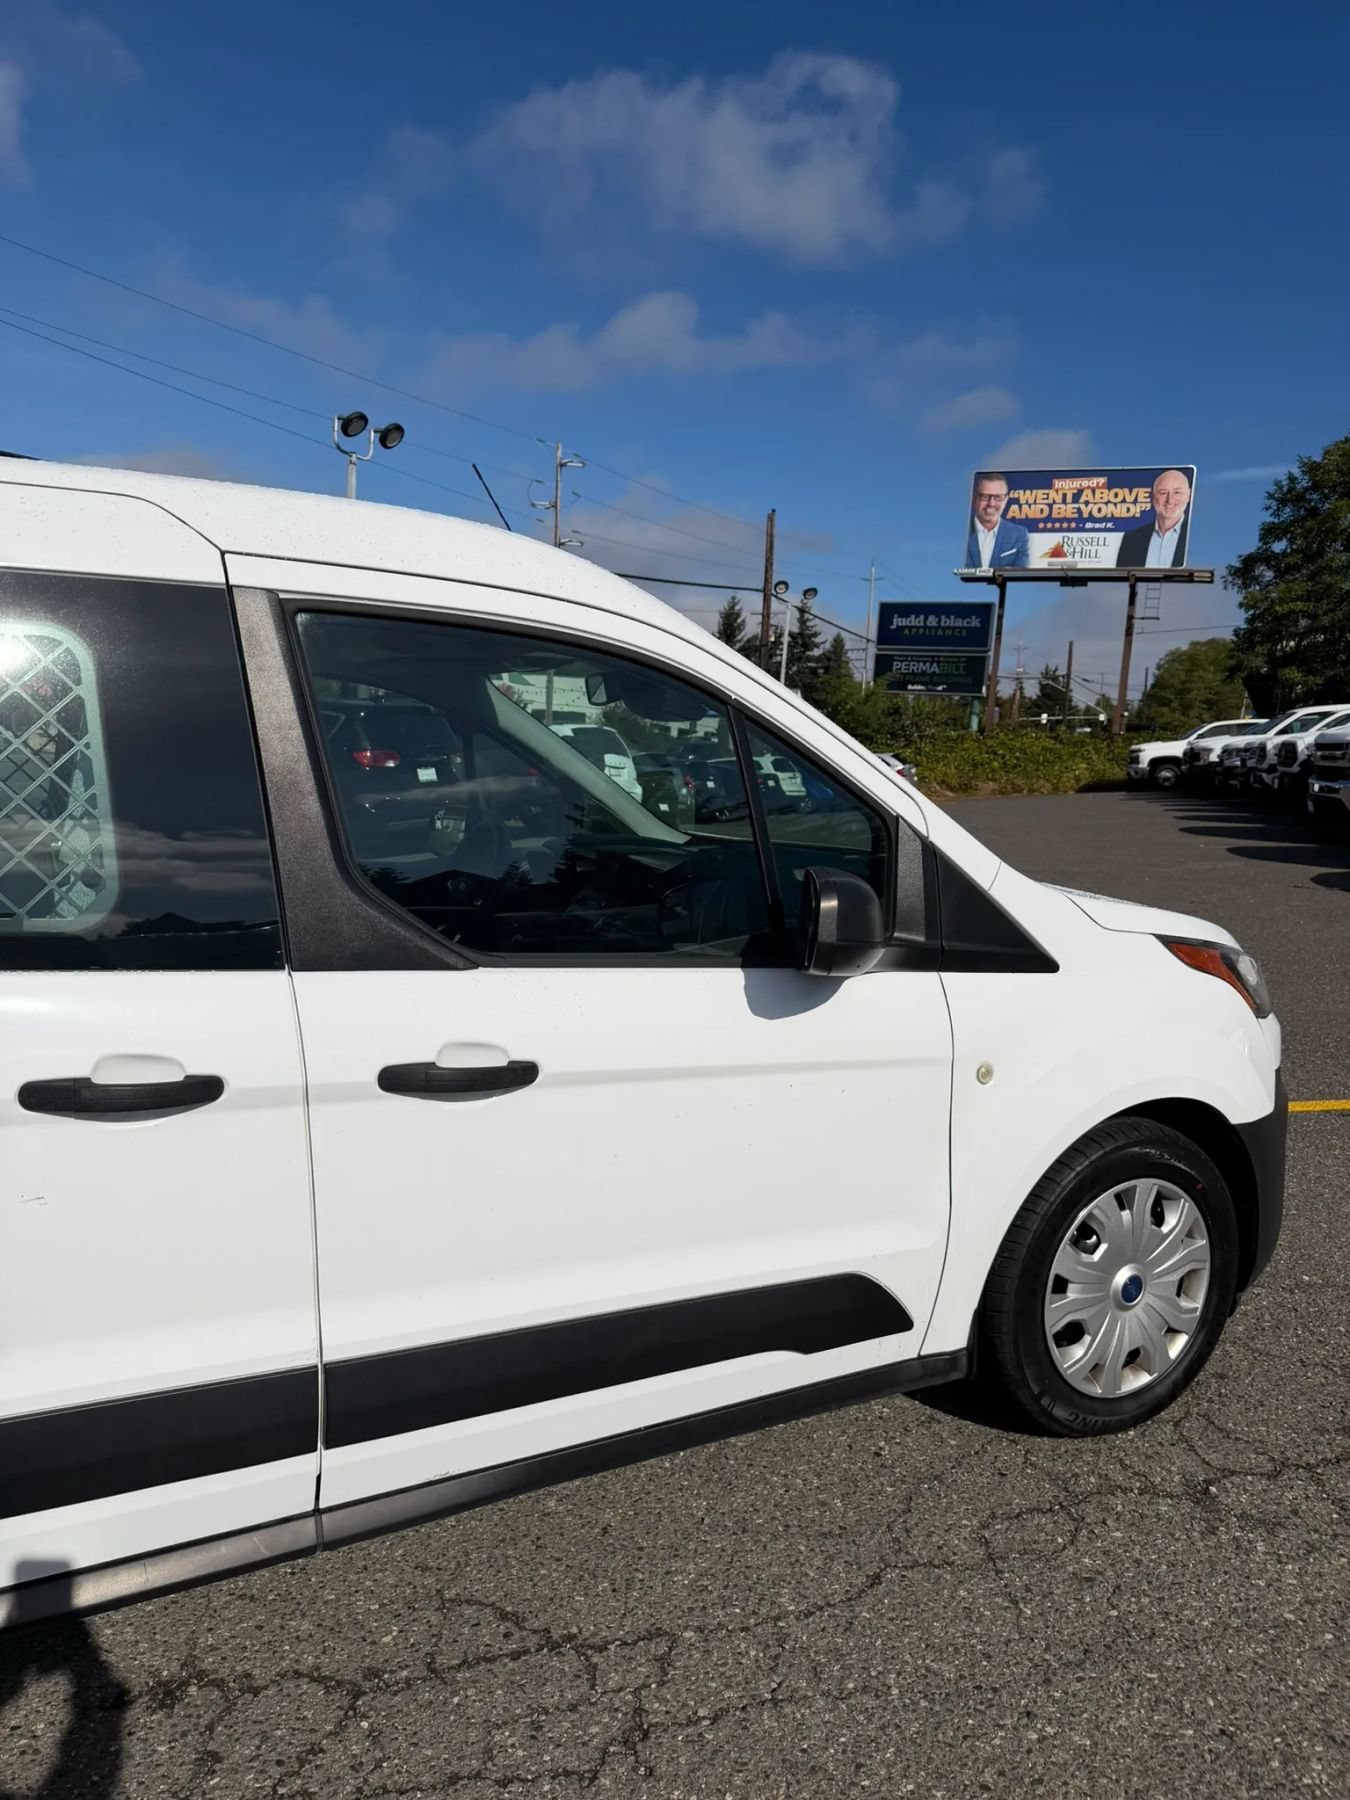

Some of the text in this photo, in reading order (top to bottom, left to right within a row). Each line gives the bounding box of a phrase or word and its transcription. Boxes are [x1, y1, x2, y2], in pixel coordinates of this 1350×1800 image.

[1055, 479, 1104, 490] Injured?
[1080, 488, 1151, 503] ABOVE
[1006, 504, 1049, 519] AND
[1061, 535, 1108, 548] RUSSELL
[890, 613, 981, 629] judd & black
[904, 628, 967, 637] APPLIANCE
